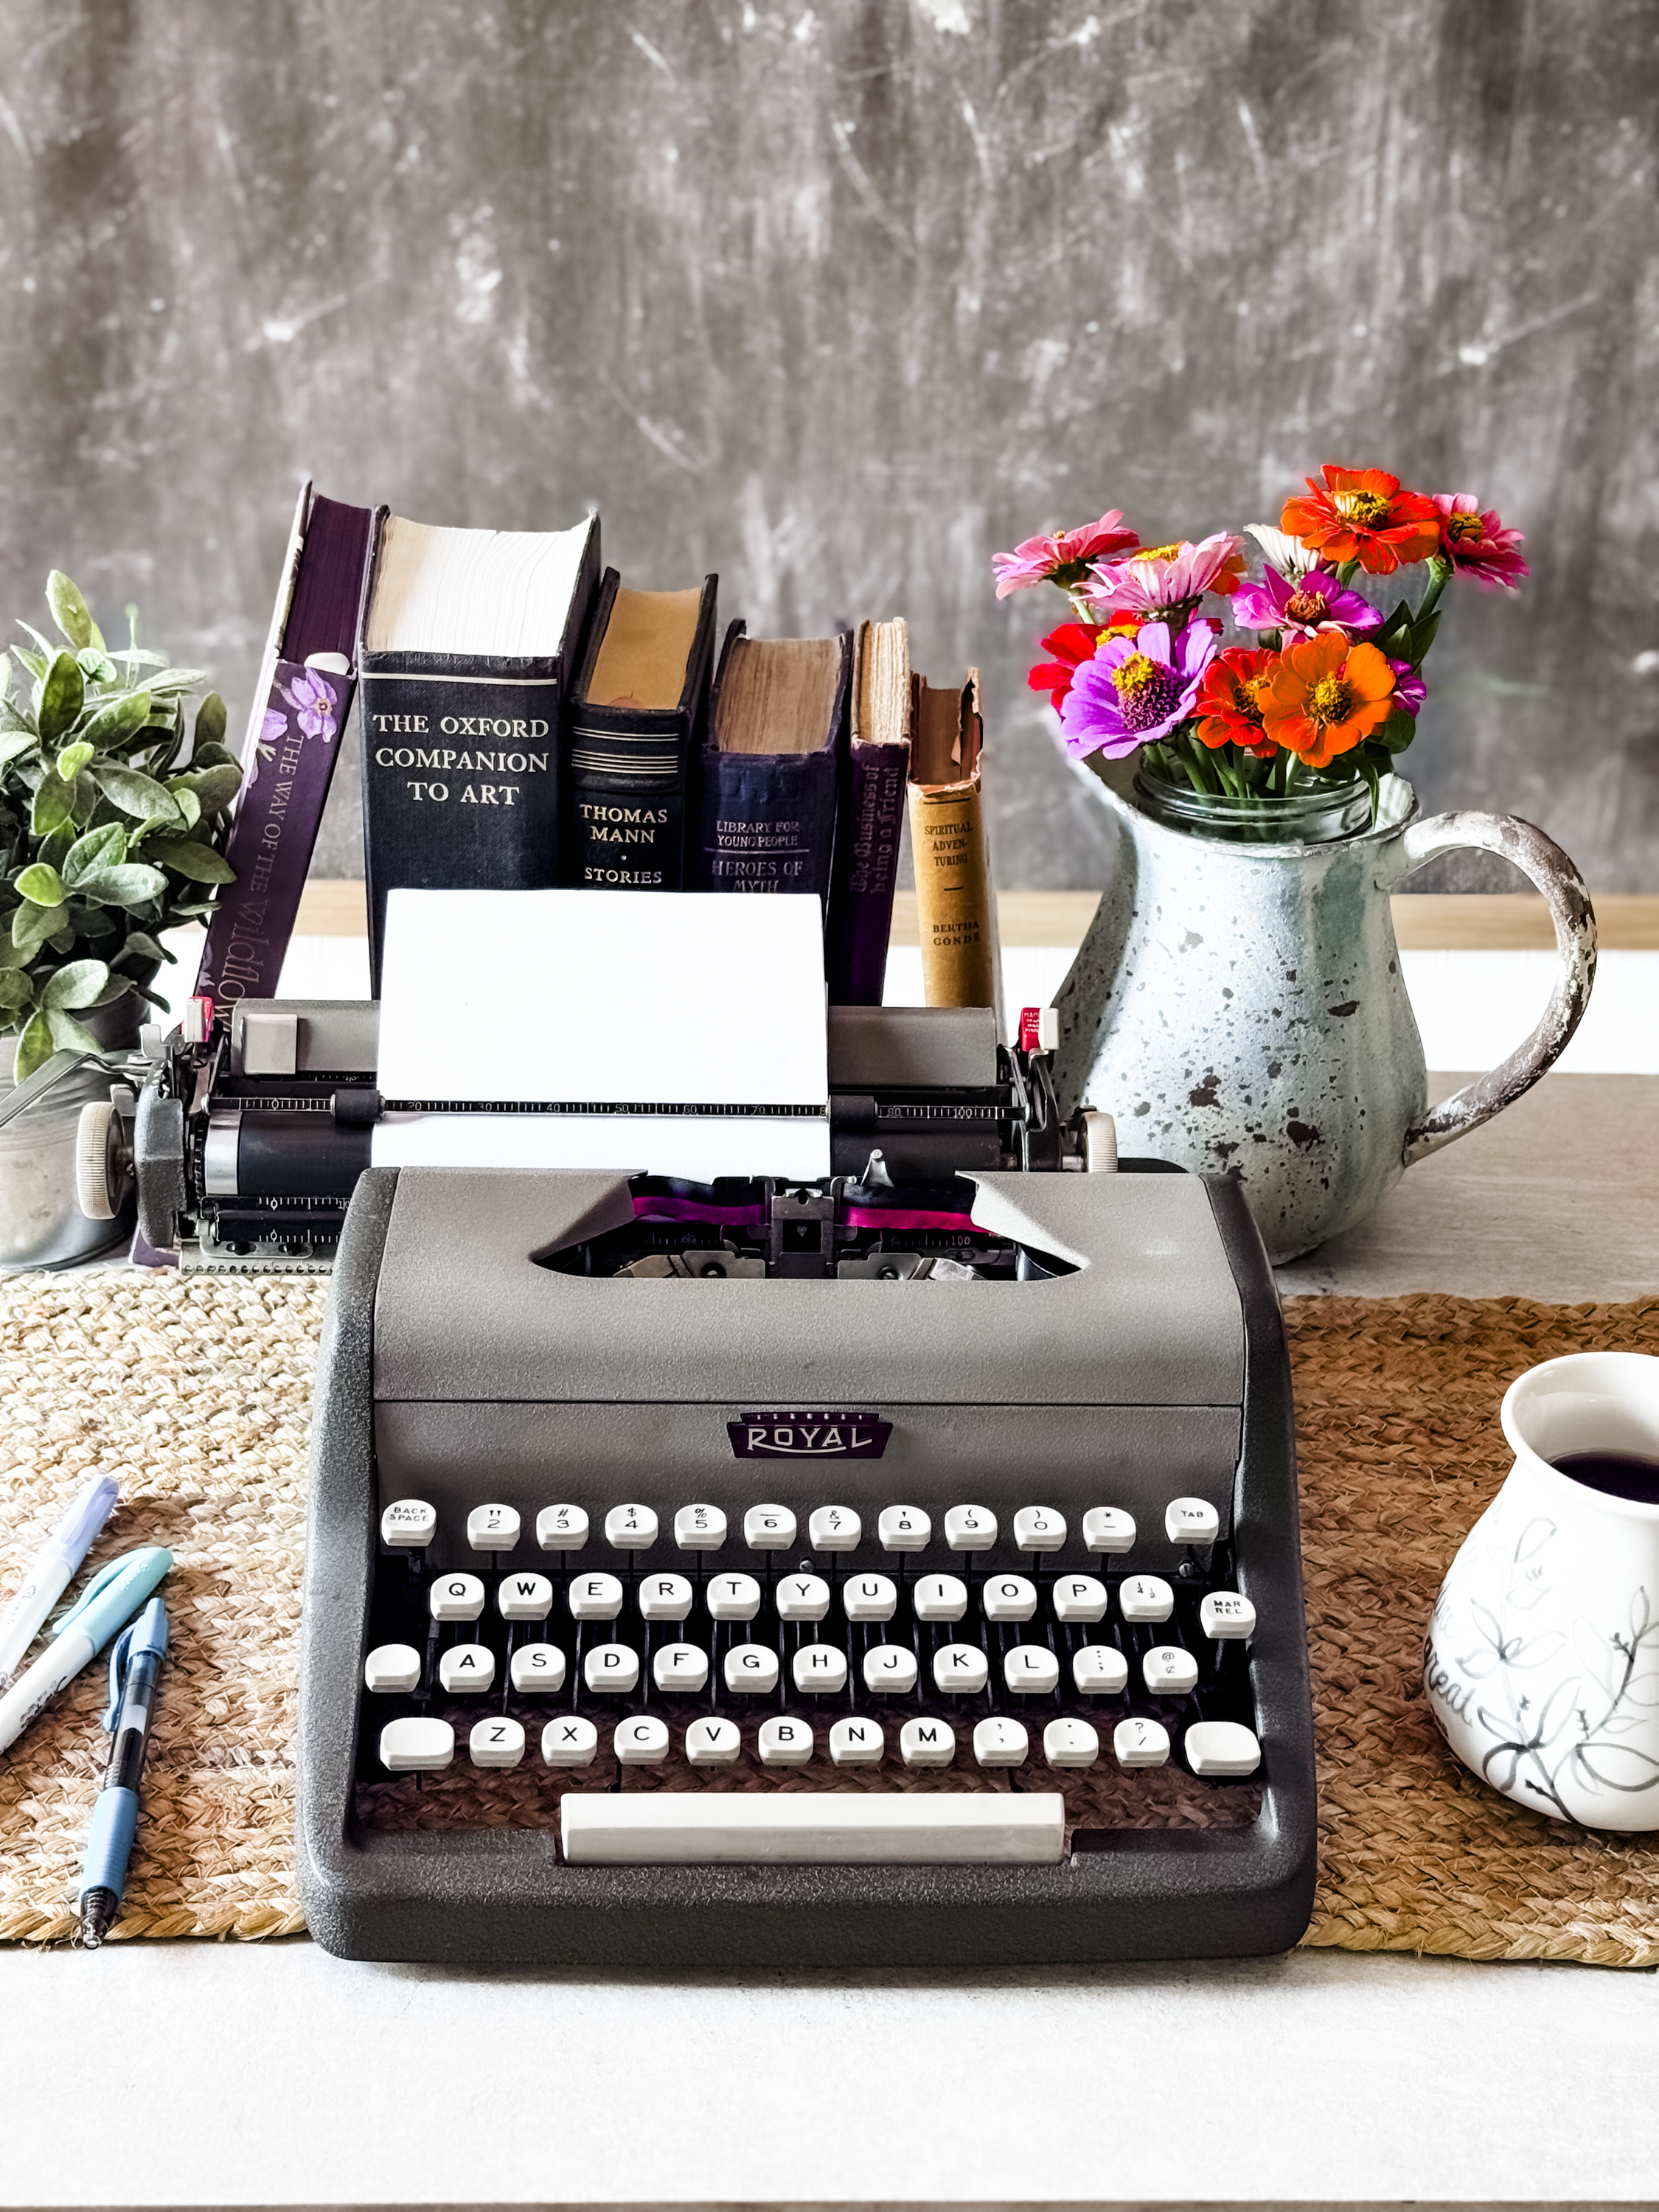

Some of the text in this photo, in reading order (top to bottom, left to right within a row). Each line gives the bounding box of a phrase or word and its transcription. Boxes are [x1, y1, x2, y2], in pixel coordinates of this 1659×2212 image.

[372, 714, 549, 738] THE OXFORD
[278, 735, 305, 776] THE
[375, 748, 549, 773] COMPANION
[268, 779, 293, 821] WAY
[407, 782, 520, 805] TO ART
[580, 804, 667, 824] THOMAS
[590, 826, 655, 844] MANN
[716, 820, 800, 833] LIBRARY FOR
[850, 762, 880, 893] The Business of
[870, 768, 899, 894] being a Friend
[924, 821, 973, 836] SPIRITUAL
[262, 824, 282, 852] OF
[717, 835, 799, 847] YOUNG PEOPLE
[932, 838, 967, 852] ADVEN-
[712, 860, 804, 877] HEROES OF
[933, 854, 967, 867] TURING
[251, 852, 275, 893] THE
[584, 867, 662, 884] STORIES
[734, 880, 779, 892] MYTH
[932, 921, 980, 934] BERTHA
[408, 1102, 422, 1111] 20
[479, 1102, 493, 1112] 30
[546, 1102, 561, 1113] 40
[615, 1103, 629, 1113] 50
[683, 1105, 698, 1114] 60
[751, 1105, 765, 1115] 70
[818, 1106, 827, 1116] 8
[887, 1107, 901, 1117] 90
[953, 1107, 973, 1119] 100
[747, 1427, 873, 1453] ROYAL
[389, 1514, 429, 1522] SPACE
[394, 1506, 428, 1514] BACK
[1180, 1510, 1204, 1518] TAB
[487, 1519, 501, 1528] 2
[557, 1519, 570, 1528] 3
[625, 1520, 639, 1529] 4
[695, 1519, 708, 1528] 5
[764, 1519, 778, 1528] 6
[829, 1520, 842, 1531] 7
[898, 1520, 912, 1530] 8
[964, 1520, 978, 1528] 9
[448, 1581, 1088, 1598] Q W E R T Y U I O P
[459, 1652, 1040, 1669] A S D F G H J K L
[1161, 1652, 1175, 1662] @
[489, 1725, 937, 1742] Z X C V B N M
[1135, 1722, 1144, 1733] ?
